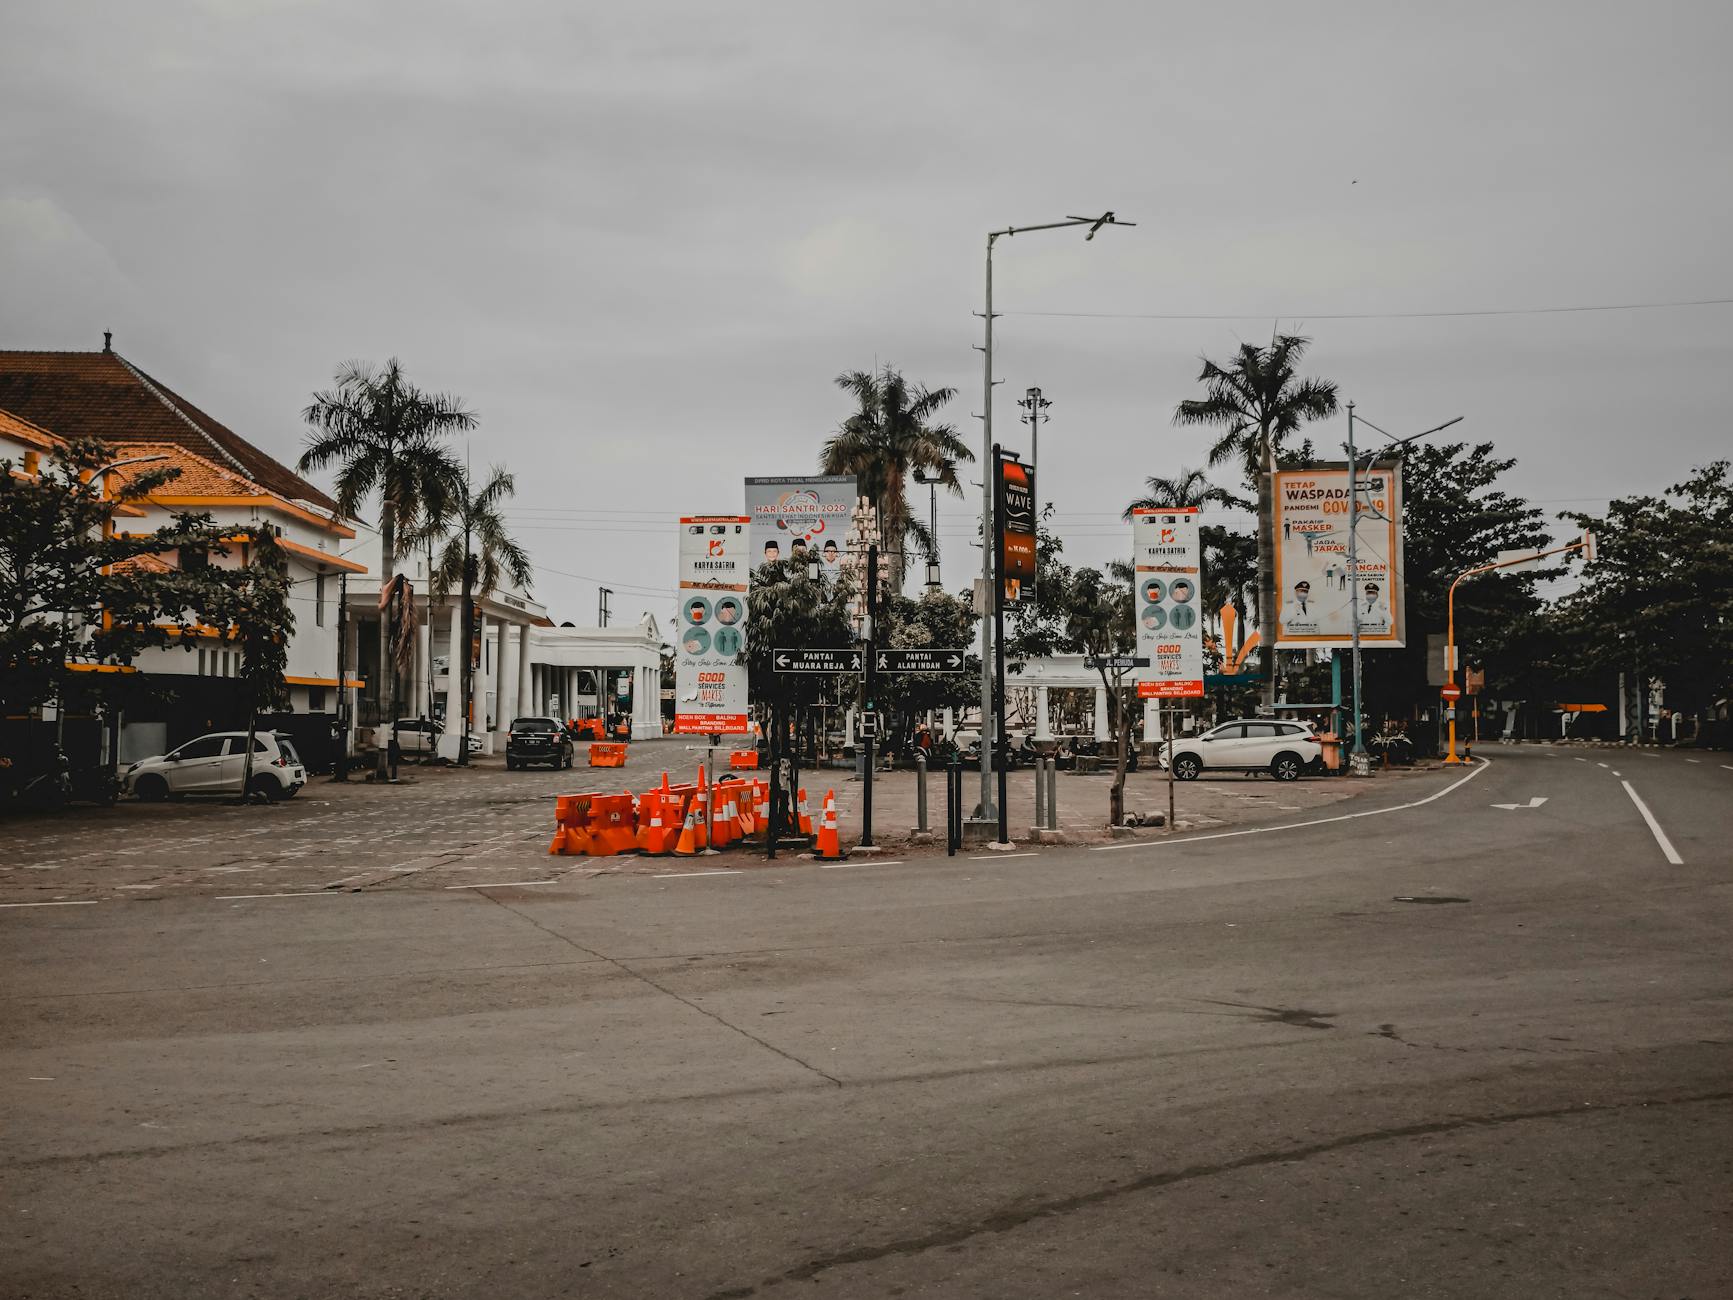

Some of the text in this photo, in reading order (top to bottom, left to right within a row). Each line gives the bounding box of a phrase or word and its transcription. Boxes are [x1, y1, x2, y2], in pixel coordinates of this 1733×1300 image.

[1006, 492, 1032, 510] WAVE
[1323, 500, 1384, 514] COVD-19
[1157, 644, 1181, 653] GOOD
[698, 672, 725, 682] GOOD
[701, 690, 722, 701] MAKES
